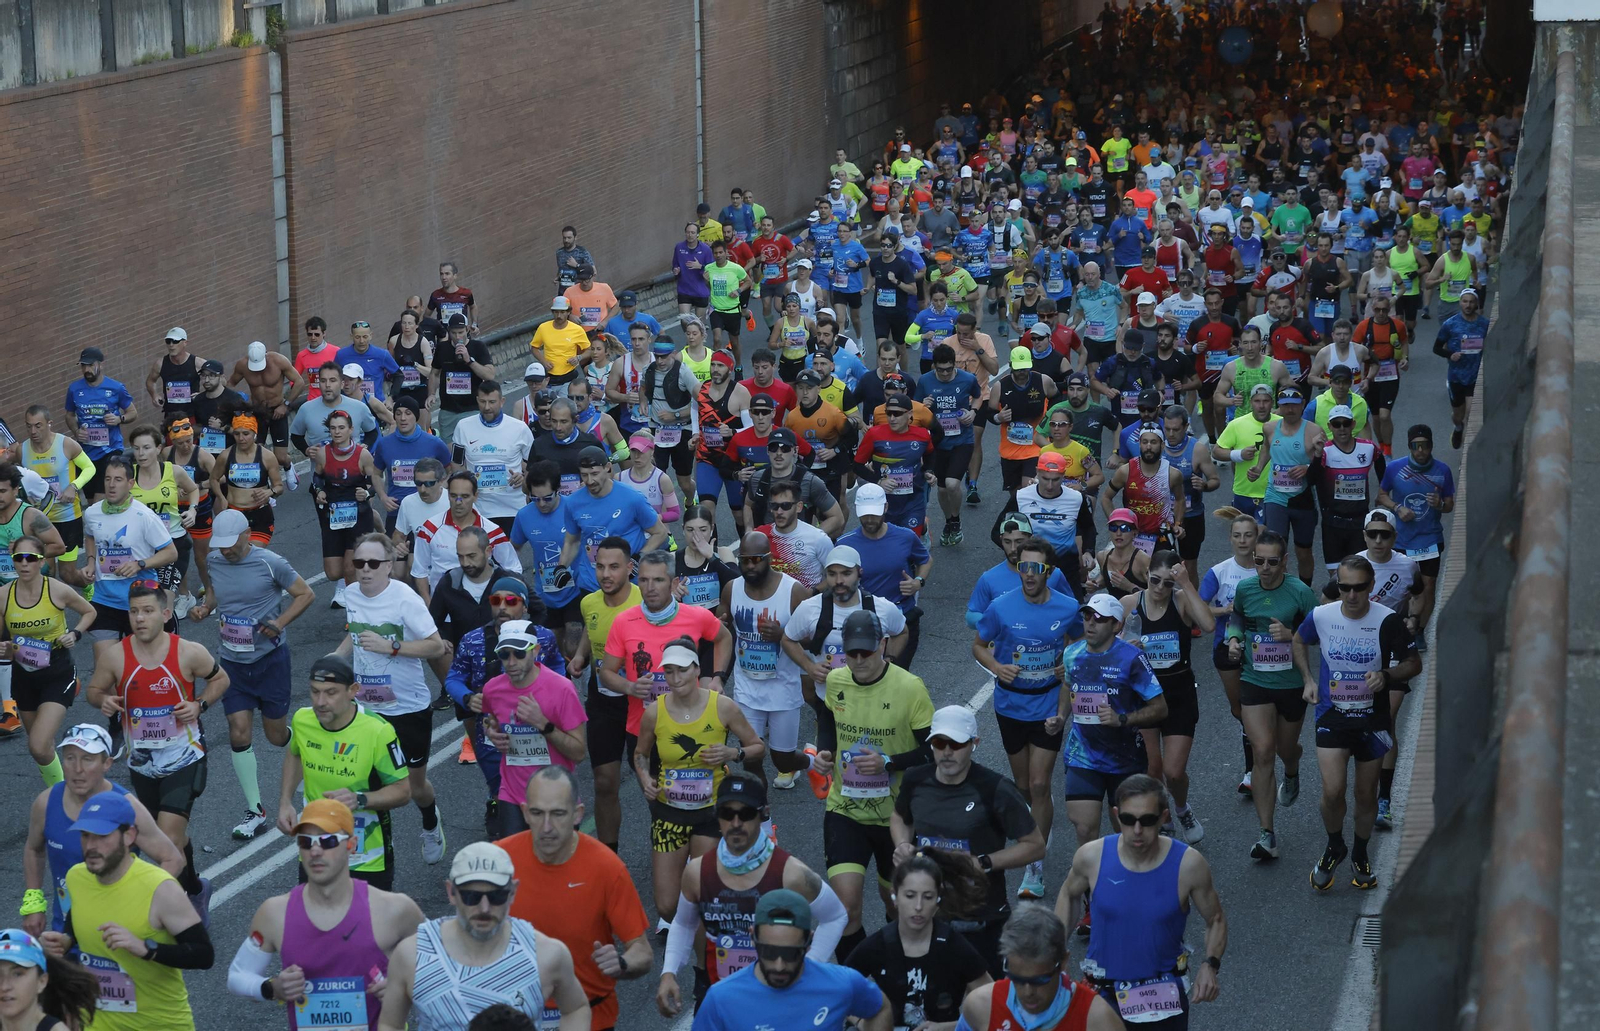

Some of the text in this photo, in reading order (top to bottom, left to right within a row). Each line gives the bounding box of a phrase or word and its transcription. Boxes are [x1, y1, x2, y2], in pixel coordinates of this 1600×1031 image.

[936, 395, 957, 403] CURSA
[692, 575, 715, 583] ZURICH
[692, 593, 711, 603] LORE
[9, 617, 51, 629] TRIBOOST
[227, 616, 249, 625] ZURICH
[220, 633, 253, 644] OUREDDINE
[1150, 633, 1175, 641] ZURICH
[1328, 635, 1377, 647] RUNNERS
[27, 639, 49, 649] ZURICH
[1028, 645, 1050, 653] ZURICH
[1254, 653, 1290, 662] JUANCHO
[747, 661, 777, 671] PALOMA
[144, 708, 169, 716] ZURICH
[142, 729, 167, 739] DAVID
[858, 724, 896, 737] PIRÁMIDE
[840, 733, 884, 747] MIRAFLORES
[525, 746, 548, 756] LUCIA
[317, 764, 335, 775] WITH
[933, 841, 963, 850] ZURICH
[704, 911, 732, 921] SAN
[317, 981, 356, 991] ZURICH
[320, 1000, 340, 1009] 7212
[1121, 1001, 1181, 1016] SOFIA Y ELENA
[311, 1012, 352, 1026] MARIO
